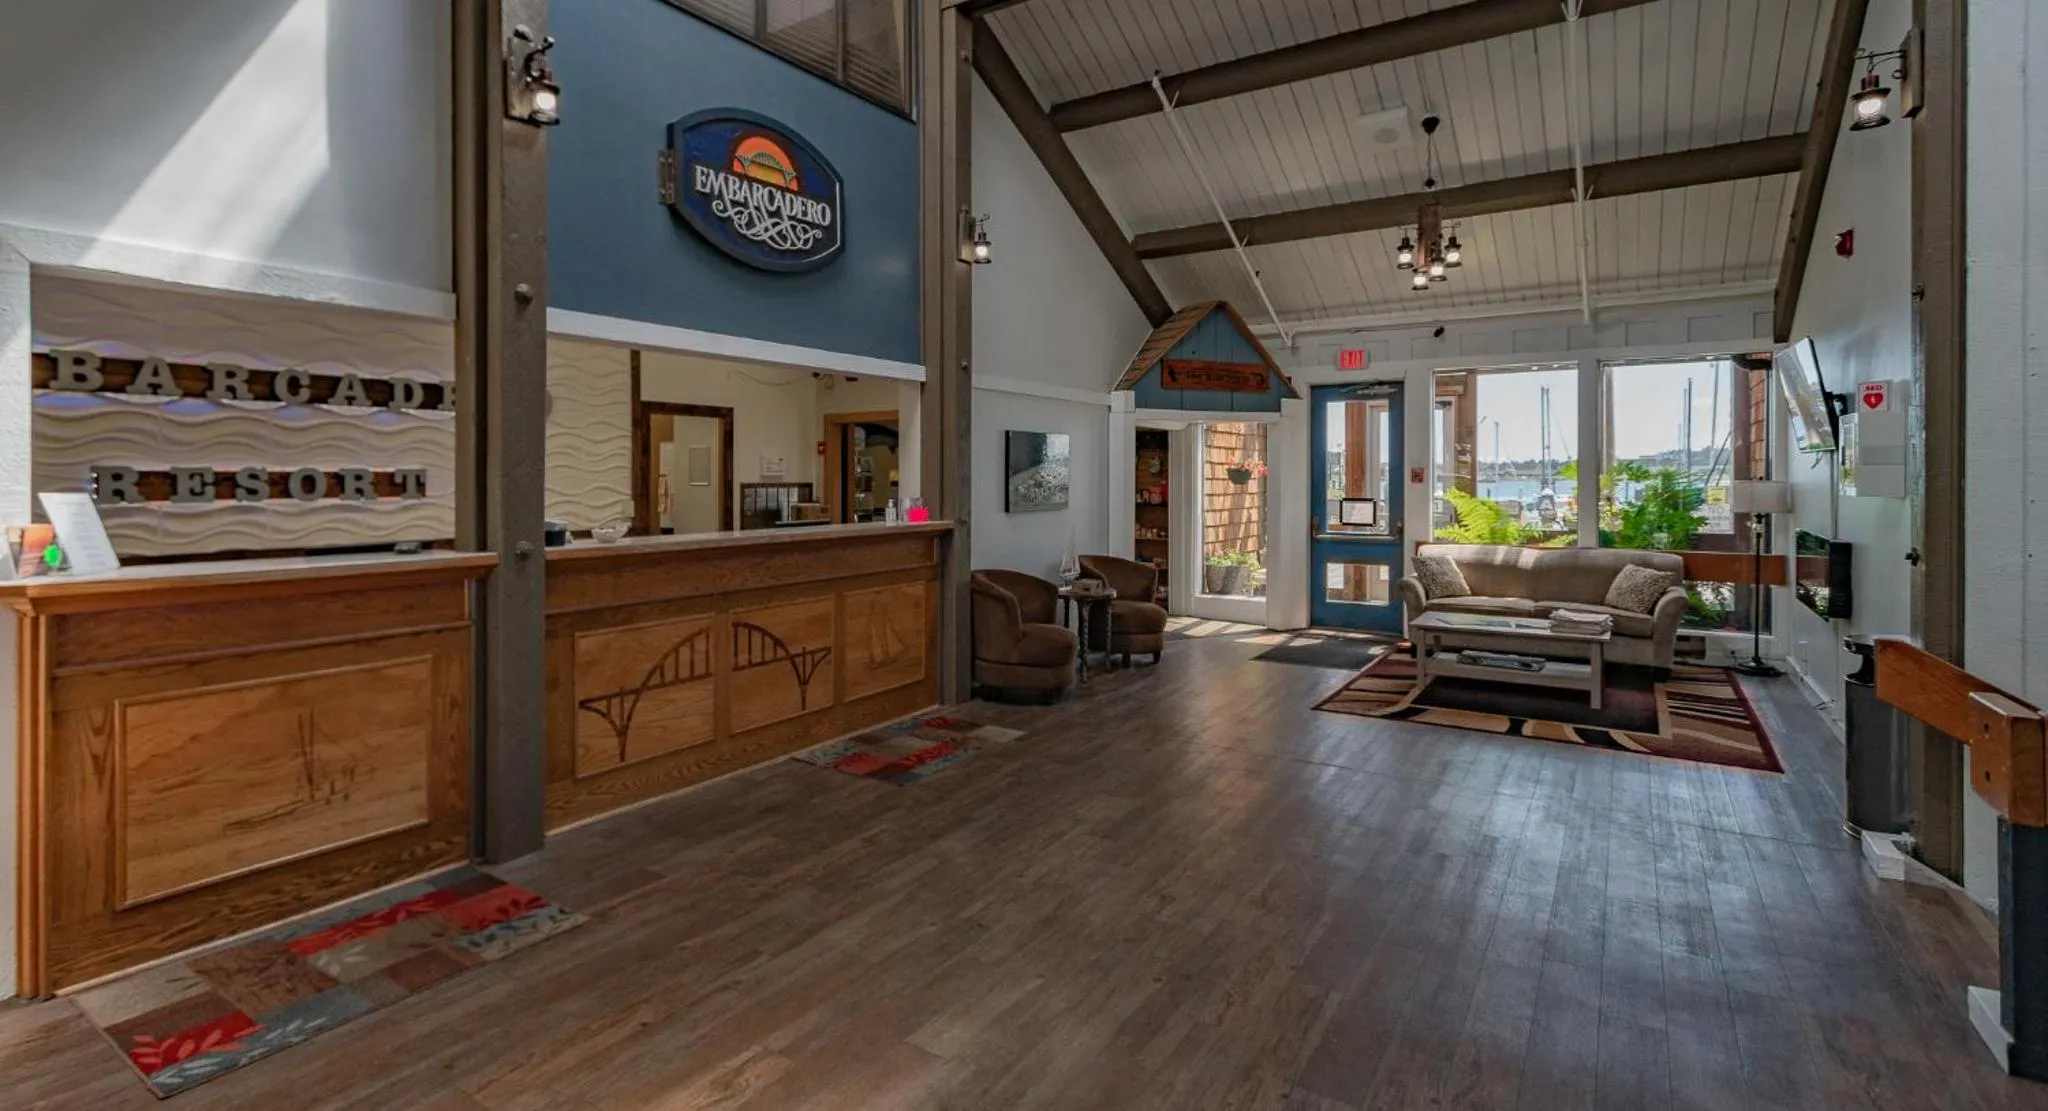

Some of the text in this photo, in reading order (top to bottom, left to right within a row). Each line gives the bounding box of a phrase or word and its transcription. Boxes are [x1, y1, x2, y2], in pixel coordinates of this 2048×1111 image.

[694, 164, 832, 249] EMBARCADERO
[1340, 349, 1365, 369] EXIT
[99, 465, 426, 502] RESORT
